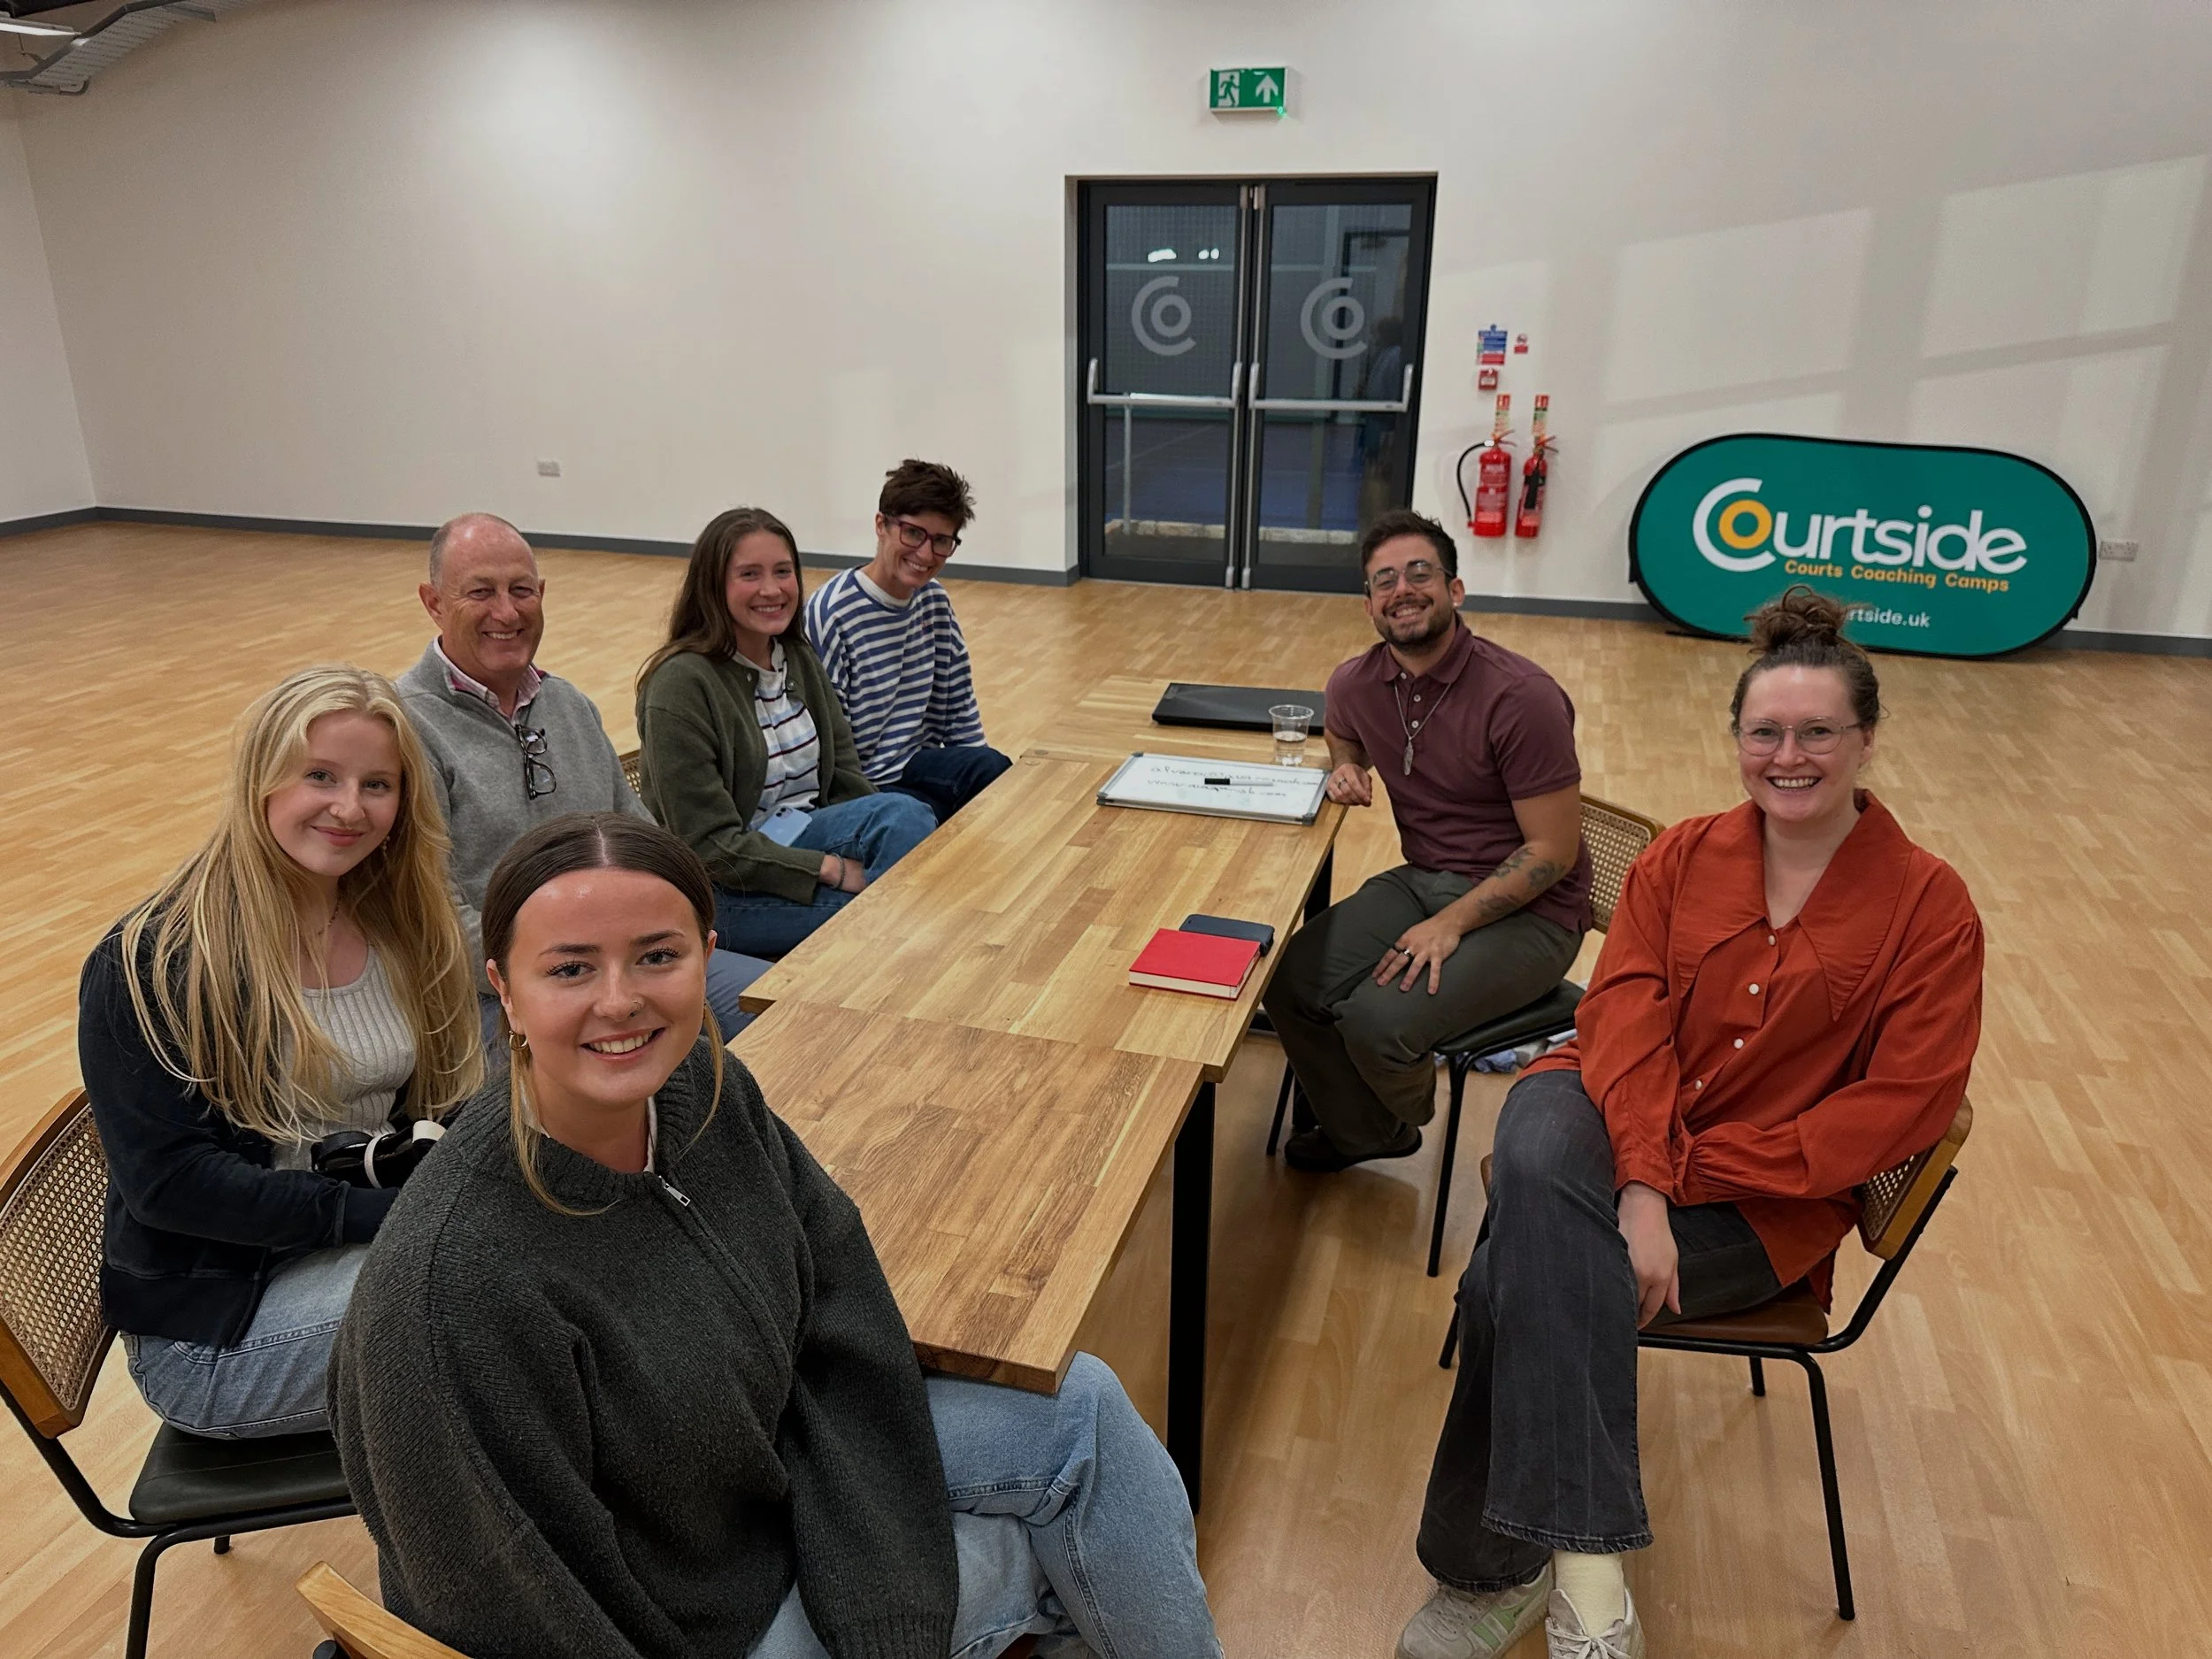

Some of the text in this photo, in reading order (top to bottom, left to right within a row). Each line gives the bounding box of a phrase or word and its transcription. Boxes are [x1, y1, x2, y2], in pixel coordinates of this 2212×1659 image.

[1693, 478, 2028, 575] Courtside
[1785, 559, 2009, 593] Courts Coaching Camps
